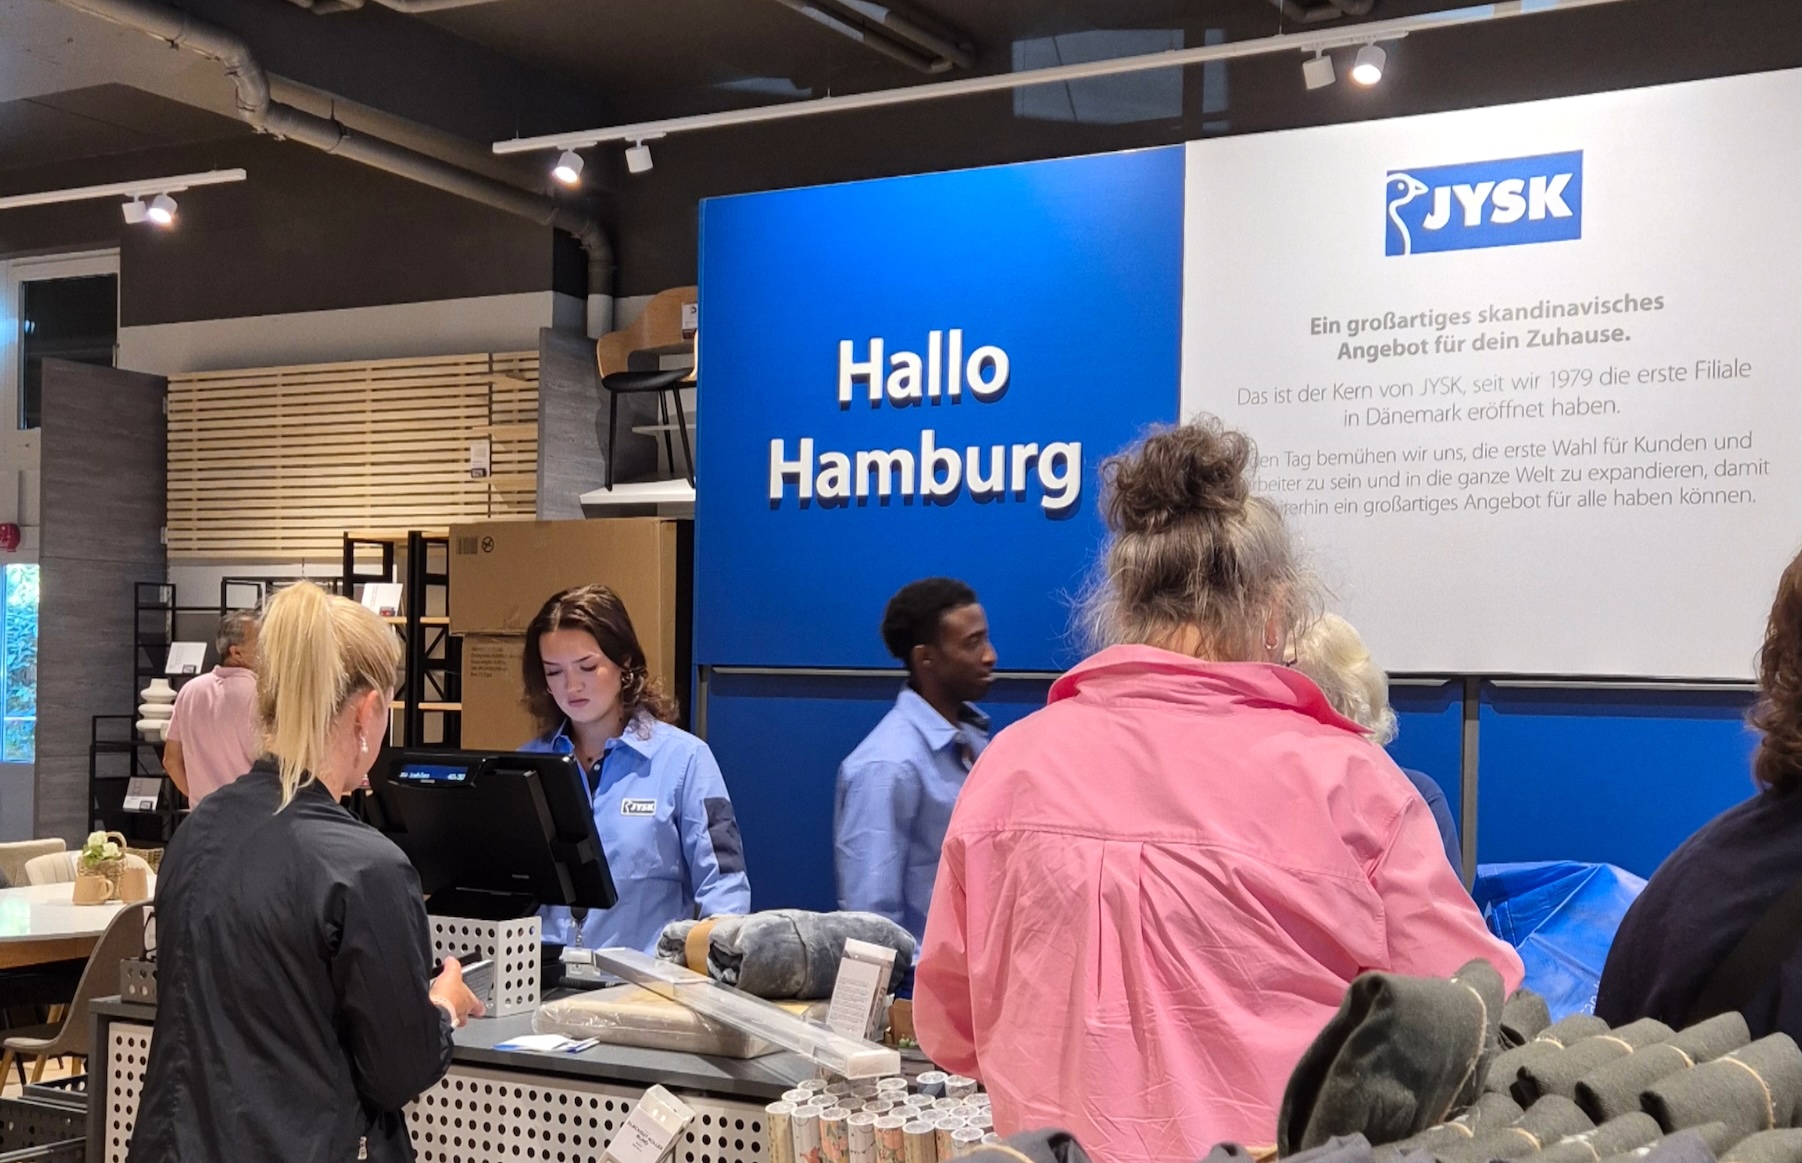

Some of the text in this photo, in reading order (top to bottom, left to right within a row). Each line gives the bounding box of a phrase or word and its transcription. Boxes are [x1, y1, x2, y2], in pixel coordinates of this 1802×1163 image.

[1423, 173, 1573, 232] JYSK
[1311, 293, 1665, 337] Ein großartiges skandinavisches
[1337, 327, 1631, 363] Angebot für dein Zuhause.
[838, 329, 1010, 404] Hallo
[1238, 358, 1751, 405] Das ist der Kern von JYSK, seit wir 1979 die erste Filiale
[1344, 396, 1620, 427] in Dänemark eröffnet haben.
[1284, 451, 1310, 470] Tag
[1317, 448, 1396, 466] bemühen
[1402, 446, 1427, 462] wir
[1434, 448, 1466, 462] uns,
[1472, 442, 1498, 460] die
[1504, 443, 1546, 458] erste
[1552, 437, 1596, 456] Wahl
[1603, 436, 1628, 454] für
[1635, 434, 1706, 453] Kunden
[1715, 430, 1752, 450] und
[769, 430, 1083, 511] Hamburg
[1249, 458, 1770, 492] rbeiter zu sein und in die ganze Welt zu expandieren, damit
[1281, 487, 1756, 517] terhin ein großartiges Angebot für alle haben können.
[630, 803, 655, 812] JYSK
